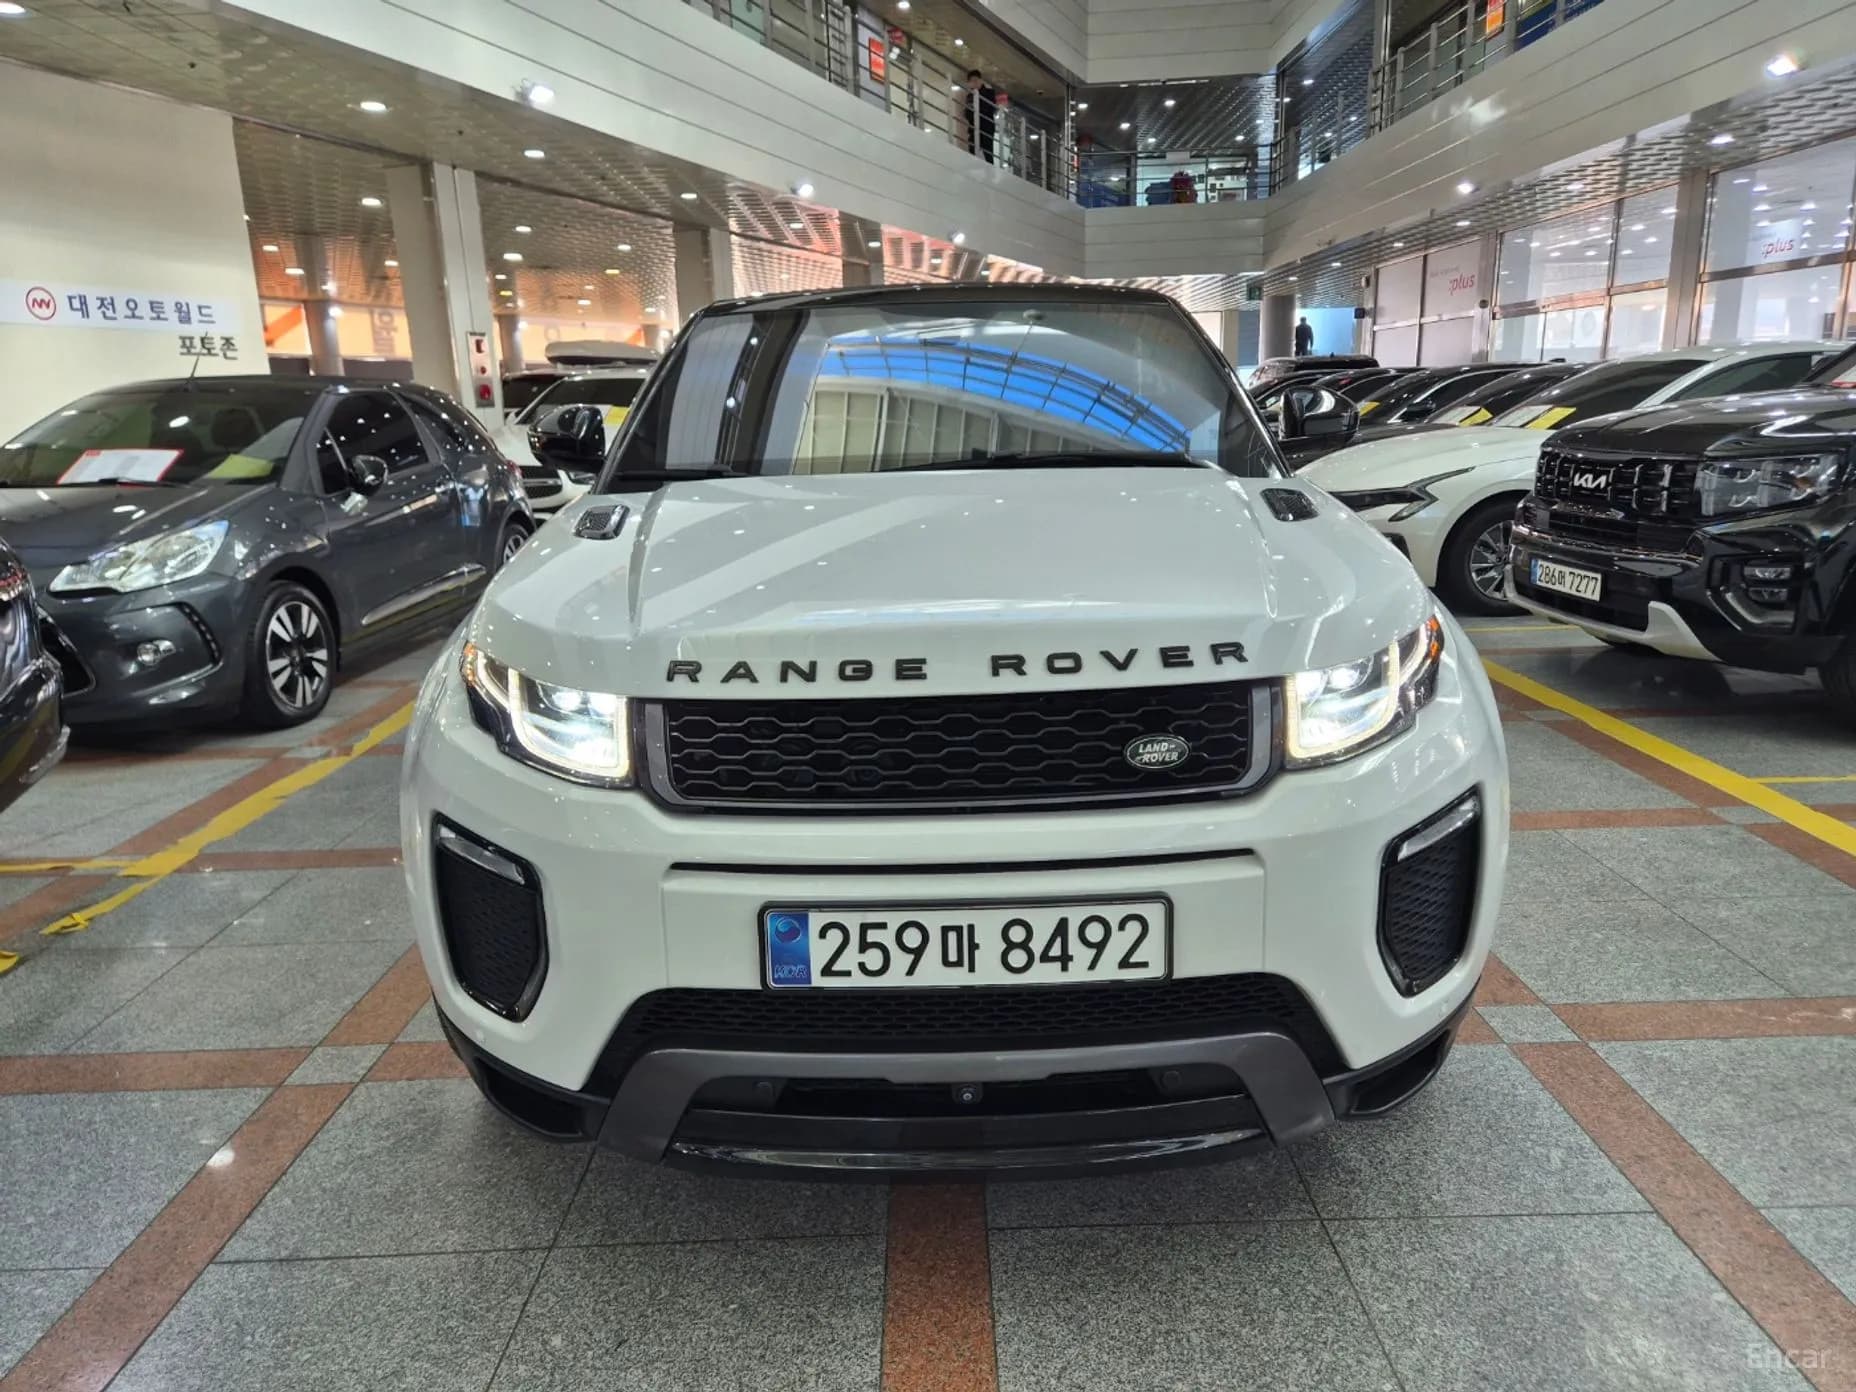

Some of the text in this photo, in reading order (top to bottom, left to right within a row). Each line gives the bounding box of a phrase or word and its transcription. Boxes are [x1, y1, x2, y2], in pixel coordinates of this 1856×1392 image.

[67, 294, 216, 325] 대전오토월드
[178, 334, 238, 361] 포토존
[1568, 571, 1599, 596] 7277
[666, 640, 1249, 684] RANGE ROVER
[818, 912, 1151, 977] 259마 8492
